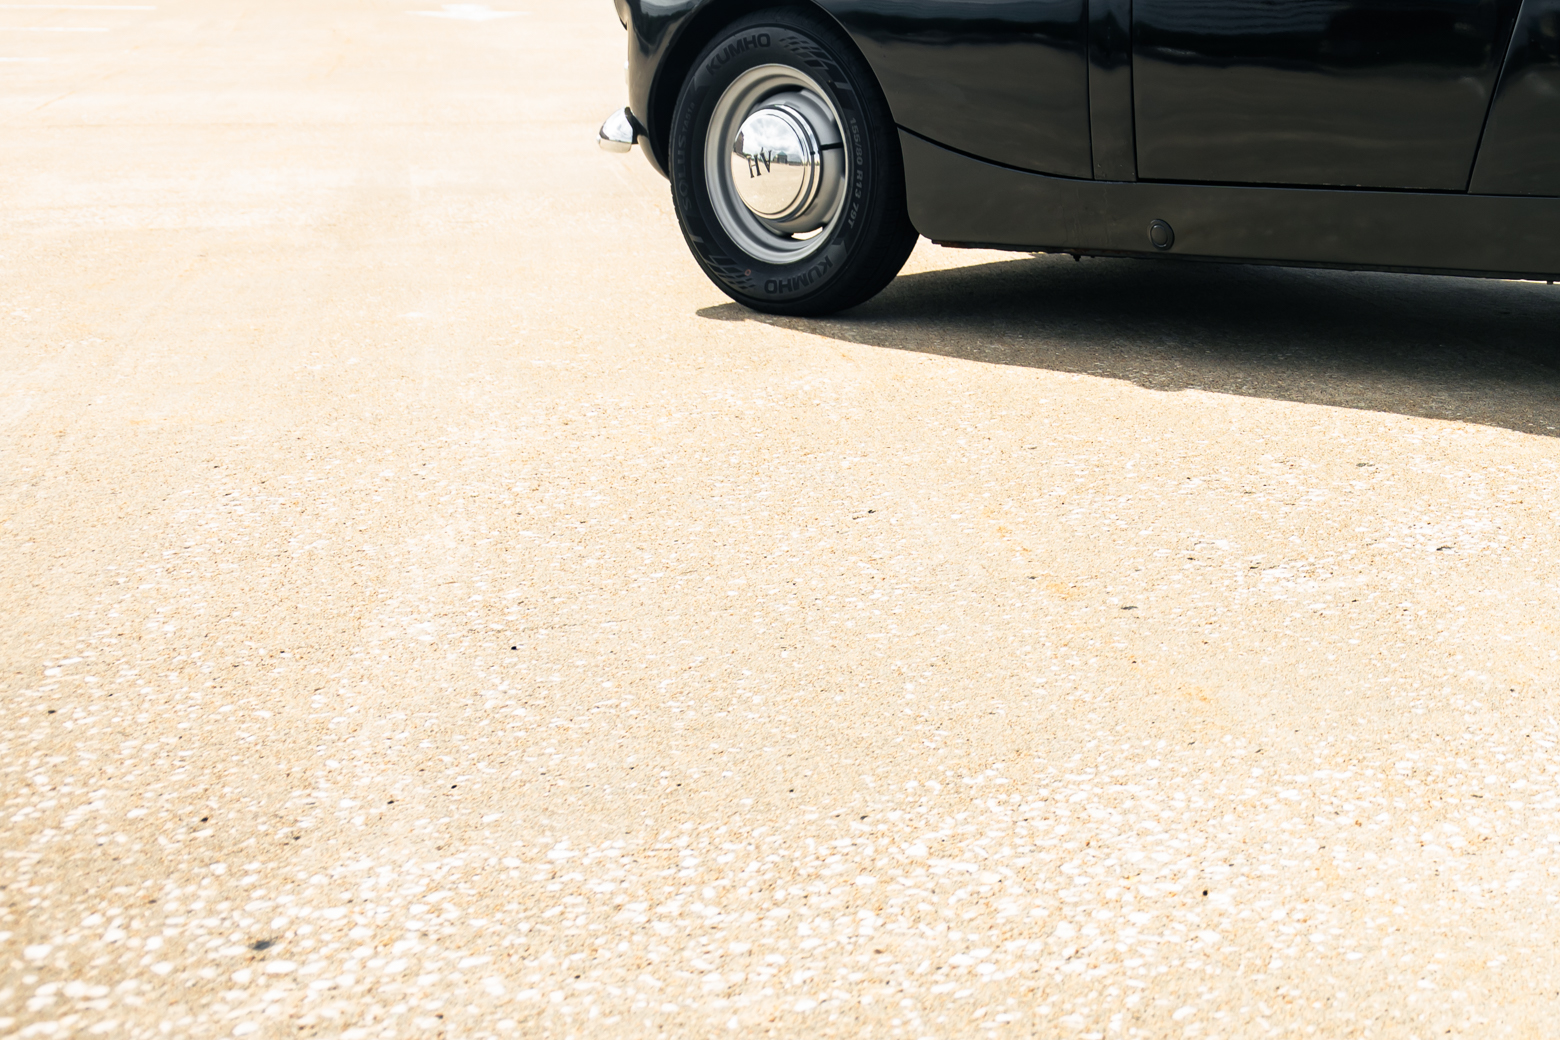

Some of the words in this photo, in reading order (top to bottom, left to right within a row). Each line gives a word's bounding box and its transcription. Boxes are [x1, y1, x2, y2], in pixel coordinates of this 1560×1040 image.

[705, 33, 771, 76] KUMHO
[850, 117, 864, 166] 155/80
[677, 134, 692, 211] SOLUS
[855, 169, 864, 199] R13
[848, 202, 860, 229] 79T
[764, 254, 834, 295] KUMHO
